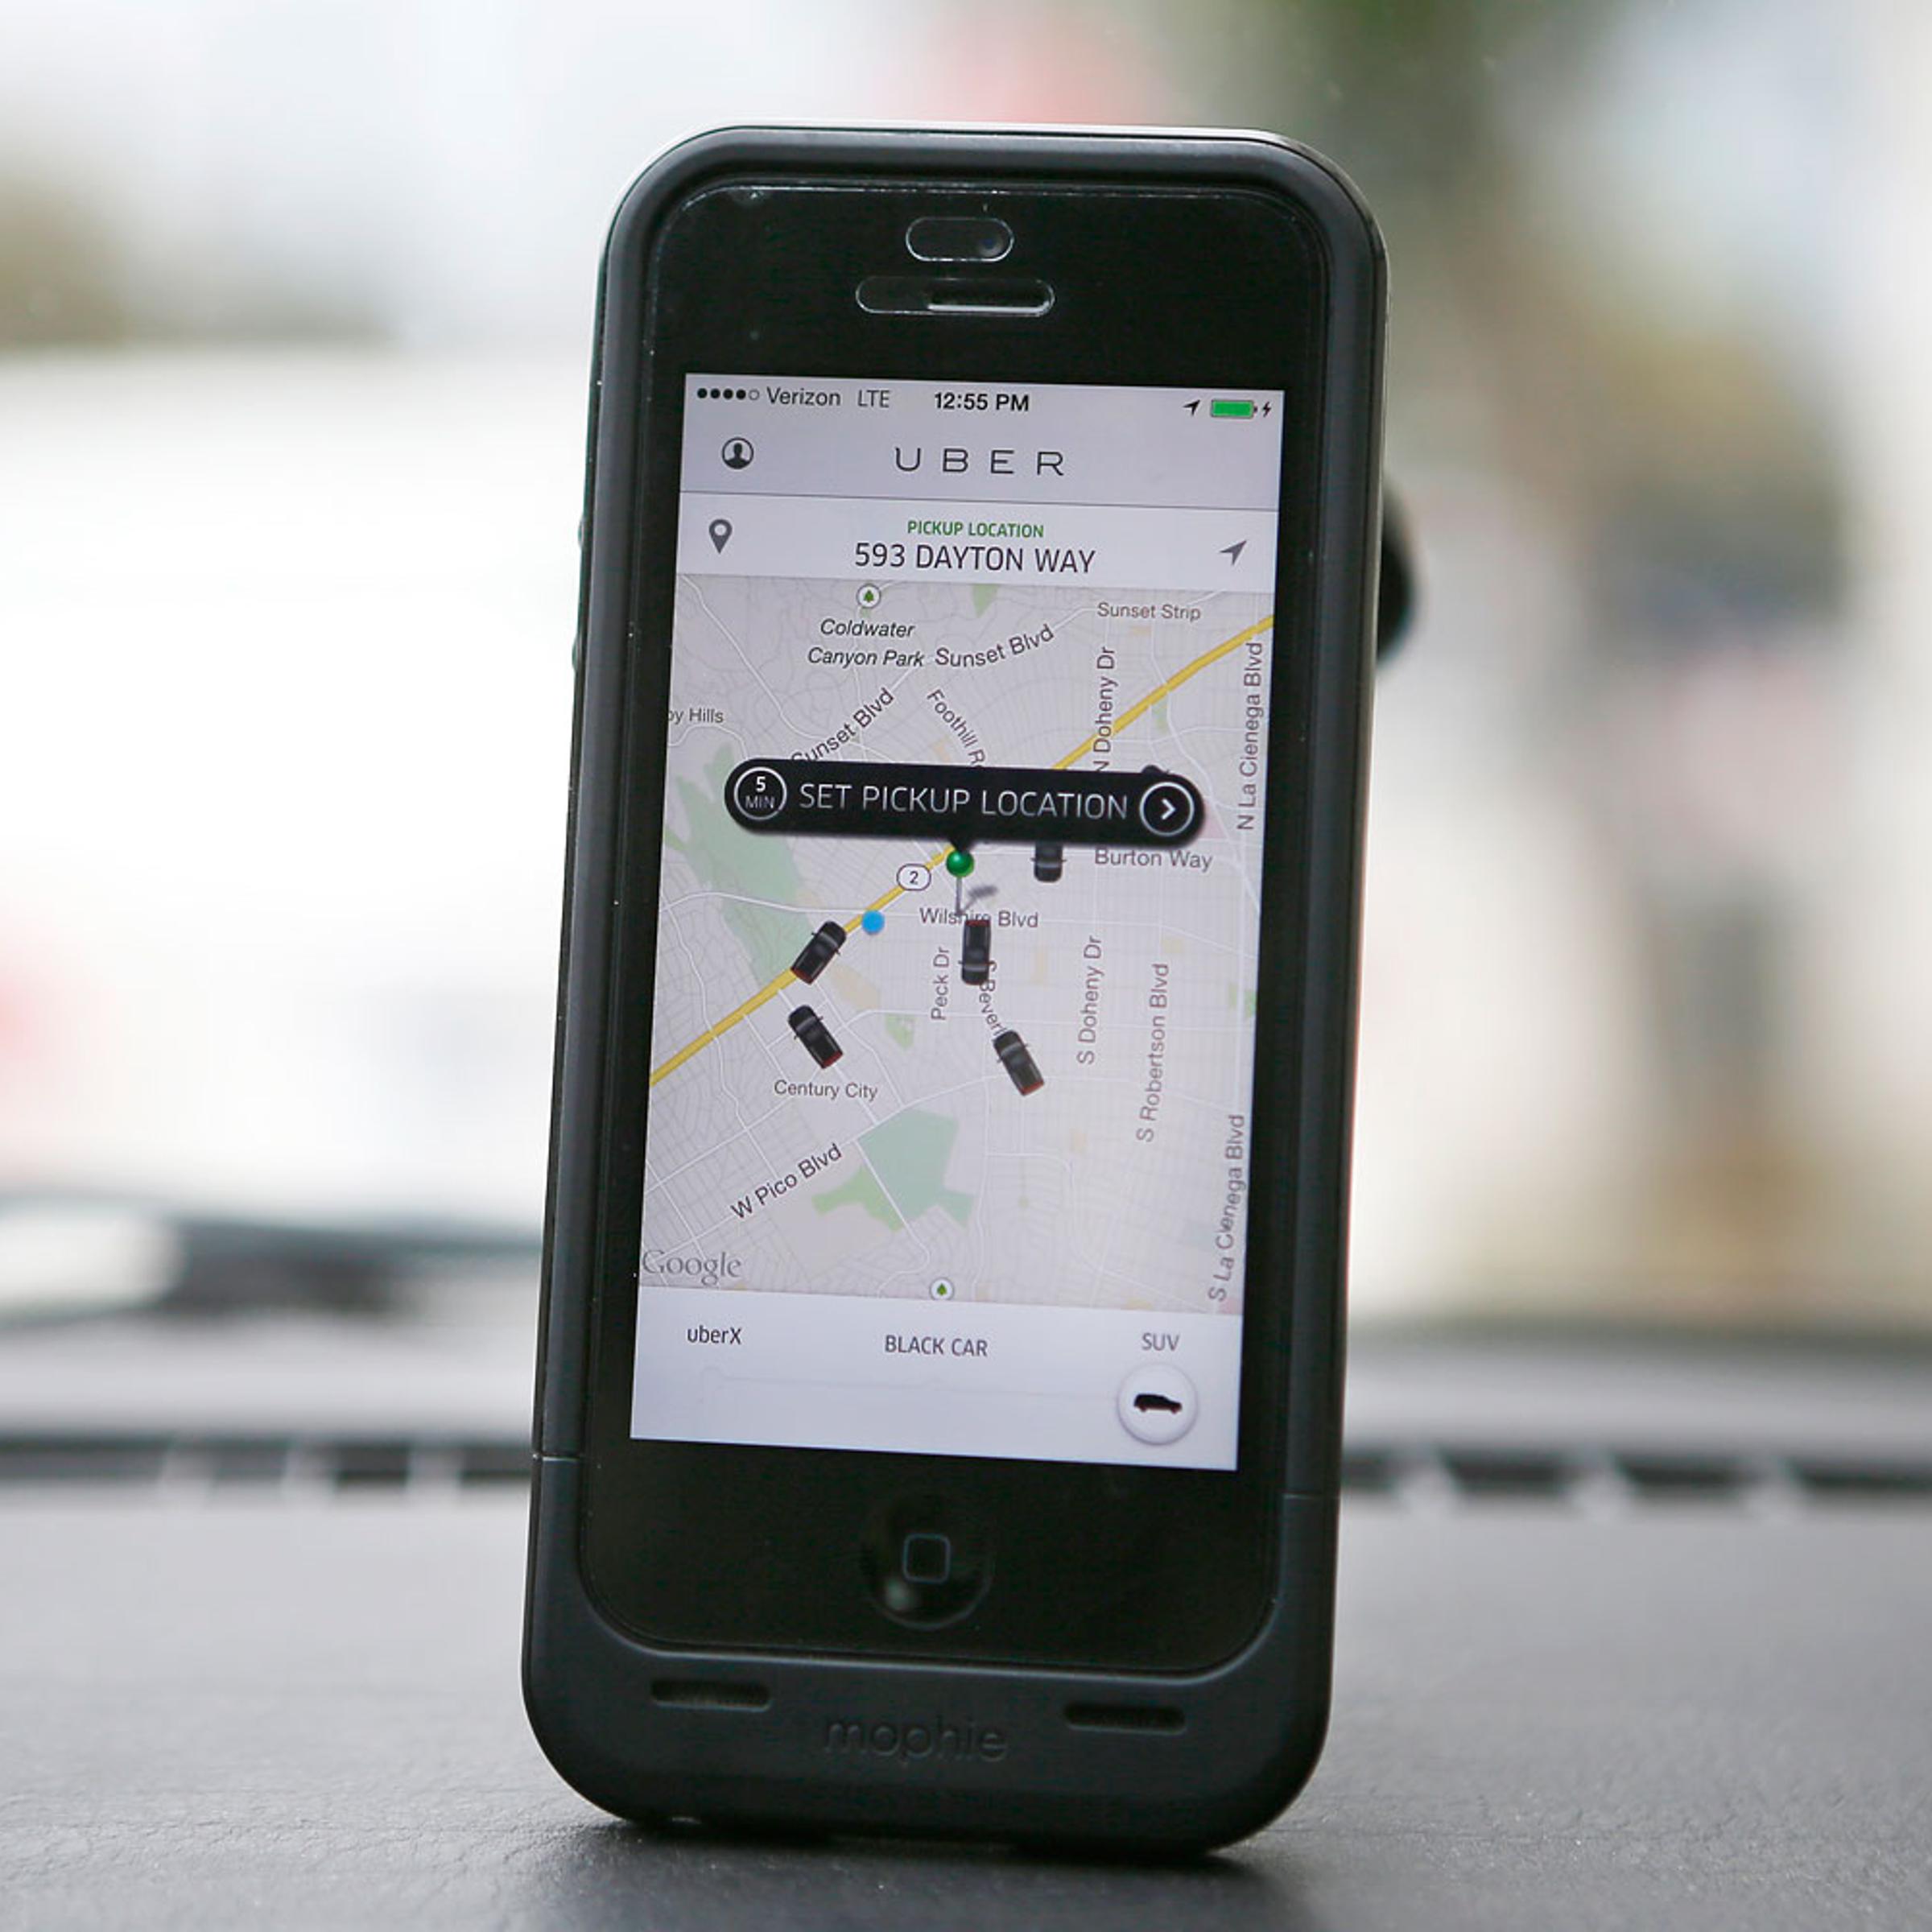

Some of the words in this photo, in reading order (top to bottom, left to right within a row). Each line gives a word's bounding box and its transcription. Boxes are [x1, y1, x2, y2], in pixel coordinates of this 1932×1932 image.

[766, 387, 841, 407] Verizon
[857, 390, 890, 408] LTE
[934, 392, 989, 411] 12:55
[996, 394, 1030, 411] PM
[895, 447, 1064, 476] UBER
[907, 520, 964, 537] PICKUP
[968, 522, 1044, 539] LOCATION
[855, 543, 906, 568] 593
[916, 545, 1023, 572] DAYTON
[1035, 548, 1096, 572] WAY
[1097, 601, 1156, 618] Sunset
[820, 618, 915, 638] Coldwater
[808, 646, 877, 669] Canyon
[883, 650, 924, 667] Park
[935, 640, 1005, 667] Sunset
[1009, 624, 1055, 654] Blvd
[1096, 646, 1115, 670] Dr
[1244, 642, 1263, 687] Blvd
[689, 708, 724, 724] Hills
[853, 687, 894, 728] Blvd
[927, 689, 979, 749] Foothill
[1093, 675, 1119, 753] Doheny
[1240, 694, 1264, 778] Cienega
[755, 775, 766, 792] 5
[1239, 783, 1257, 808] La
[745, 795, 775, 810] MIN
[799, 783, 852, 809] SET
[862, 785, 971, 814] PICKUP
[981, 790, 1128, 820] LOCATION
[1237, 815, 1254, 830] N
[1095, 846, 1162, 867] Burton
[1169, 849, 1214, 873] Way
[909, 870, 919, 886] 2
[997, 909, 1039, 928] Blvd
[932, 946, 950, 968] Dr
[1083, 935, 1102, 960] Dr
[931, 973, 949, 1021] Peck
[1149, 964, 1170, 1009] Blvd
[1077, 965, 1105, 1044] Doheny
[1076, 1050, 1095, 1065] S
[1139, 1015, 1166, 1121] Robertson
[774, 1080, 840, 1100] Century
[845, 1082, 878, 1102] City
[1136, 1128, 1155, 1143] S
[1225, 1114, 1245, 1160] Blvd
[730, 1195, 753, 1219] W
[754, 1172, 798, 1206] Pico
[798, 1142, 842, 1179] Blvd
[642, 1249, 742, 1286] Google
[1213, 1257, 1235, 1282] La
[1208, 1286, 1228, 1302] S
[687, 1325, 742, 1345] uberX
[885, 1335, 945, 1355] BLACK
[951, 1338, 989, 1356] CAR
[1141, 1333, 1180, 1352] SUV
[823, 1715, 1008, 1767] mophie
